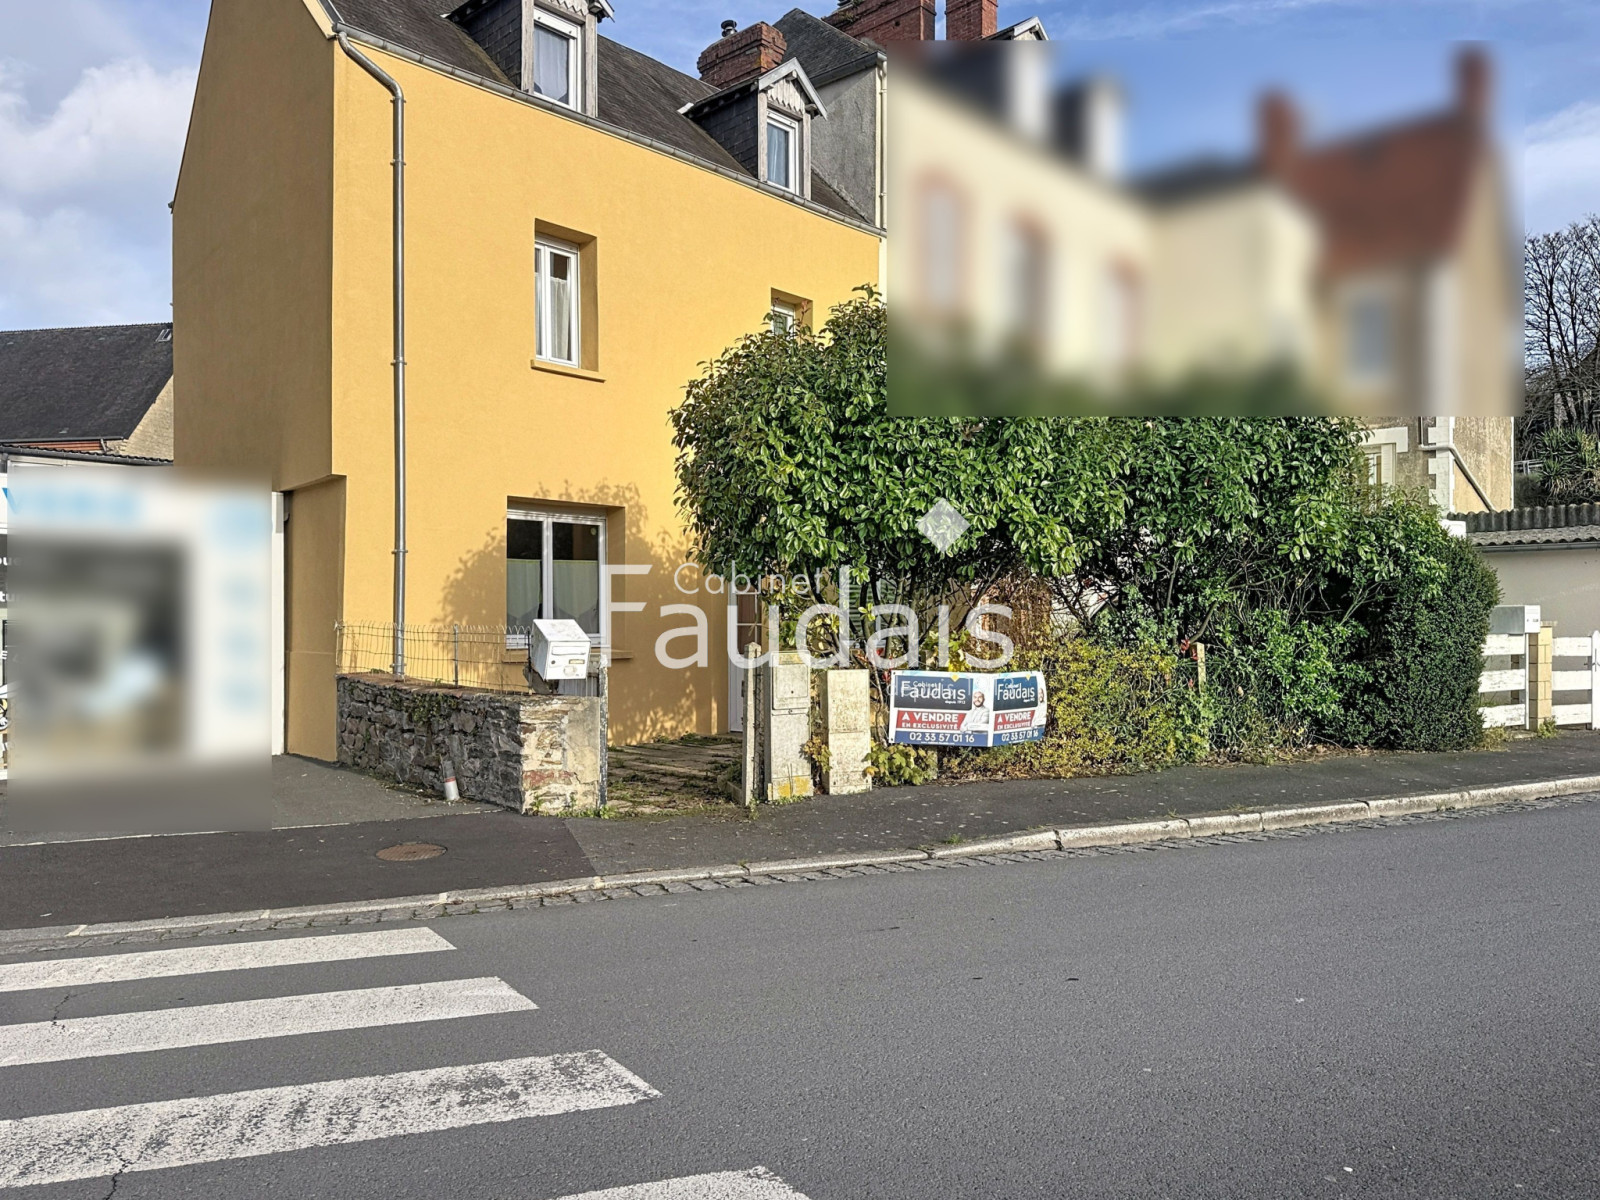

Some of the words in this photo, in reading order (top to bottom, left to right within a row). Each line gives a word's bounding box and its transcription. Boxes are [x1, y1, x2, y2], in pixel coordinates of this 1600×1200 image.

[901, 680, 966, 700] Faudais
[997, 683, 1035, 700] Faudais
[902, 712, 910, 721] A
[913, 712, 958, 723] VENDRE
[1004, 711, 1032, 722] VENDRE
[909, 732, 922, 741] 02
[924, 733, 936, 741] 33
[938, 734, 951, 742] 57
[952, 734, 963, 742] 01
[965, 735, 975, 743] 16
